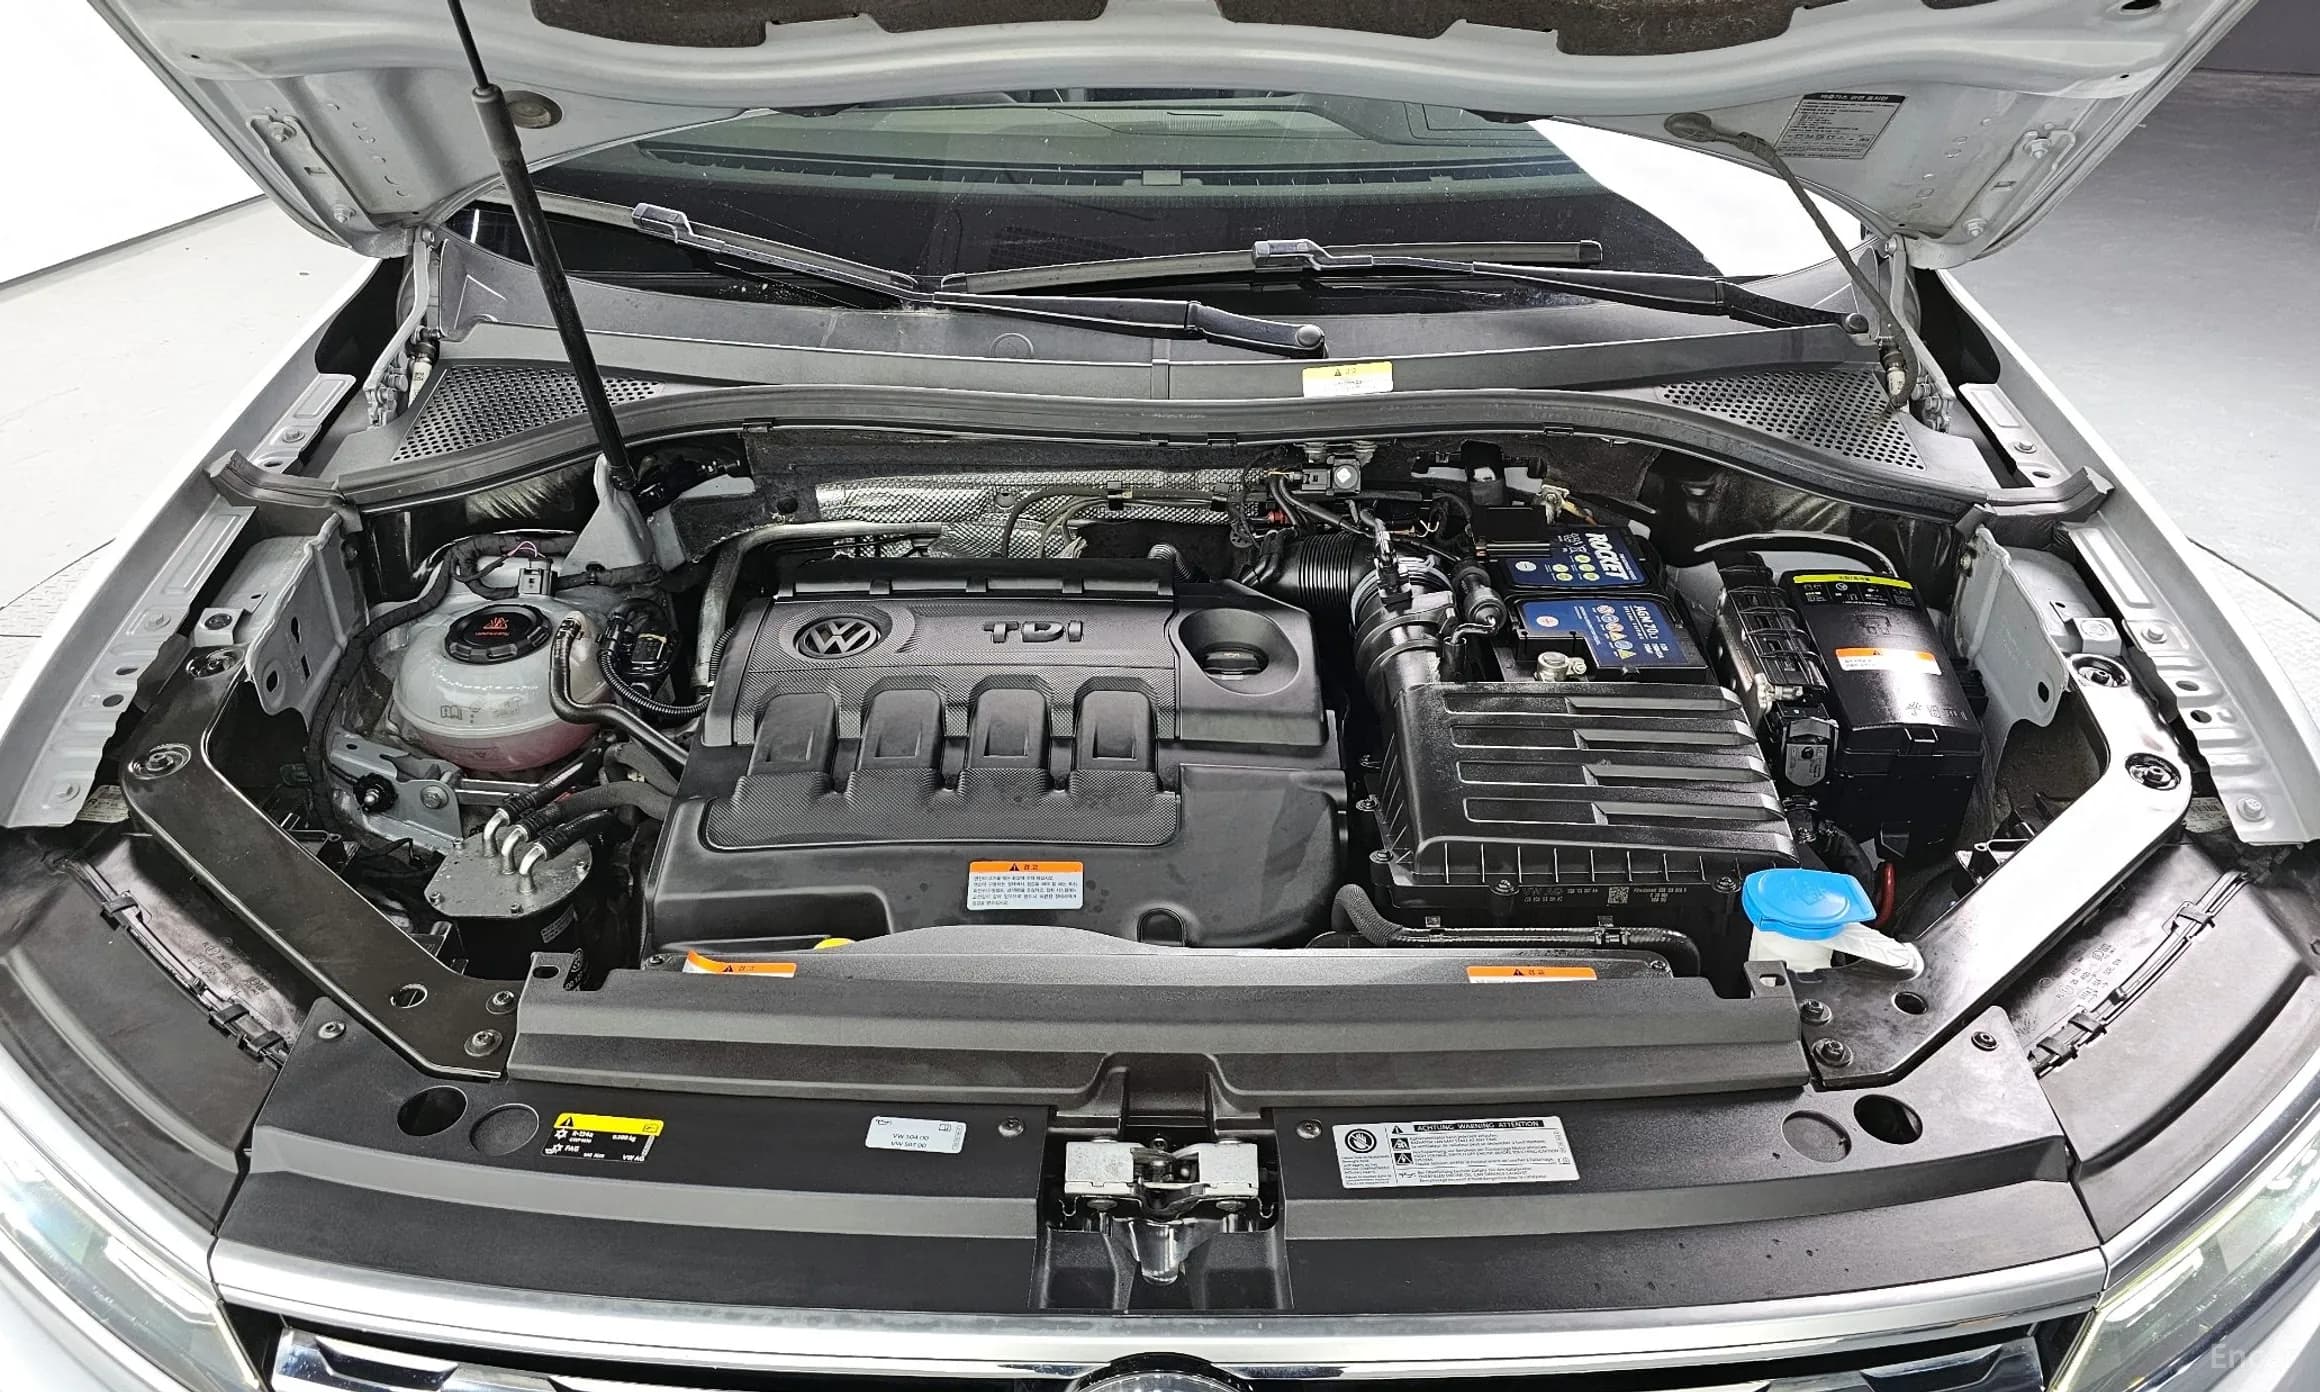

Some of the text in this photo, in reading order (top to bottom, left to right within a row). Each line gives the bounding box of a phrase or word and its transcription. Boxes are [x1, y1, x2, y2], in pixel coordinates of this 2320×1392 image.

[1585, 533, 1630, 581] ROCKET
[982, 619, 1084, 644] TDI
[1458, 1121, 1494, 1129] WARNING
[1498, 1119, 1539, 1127] ATTENTION
